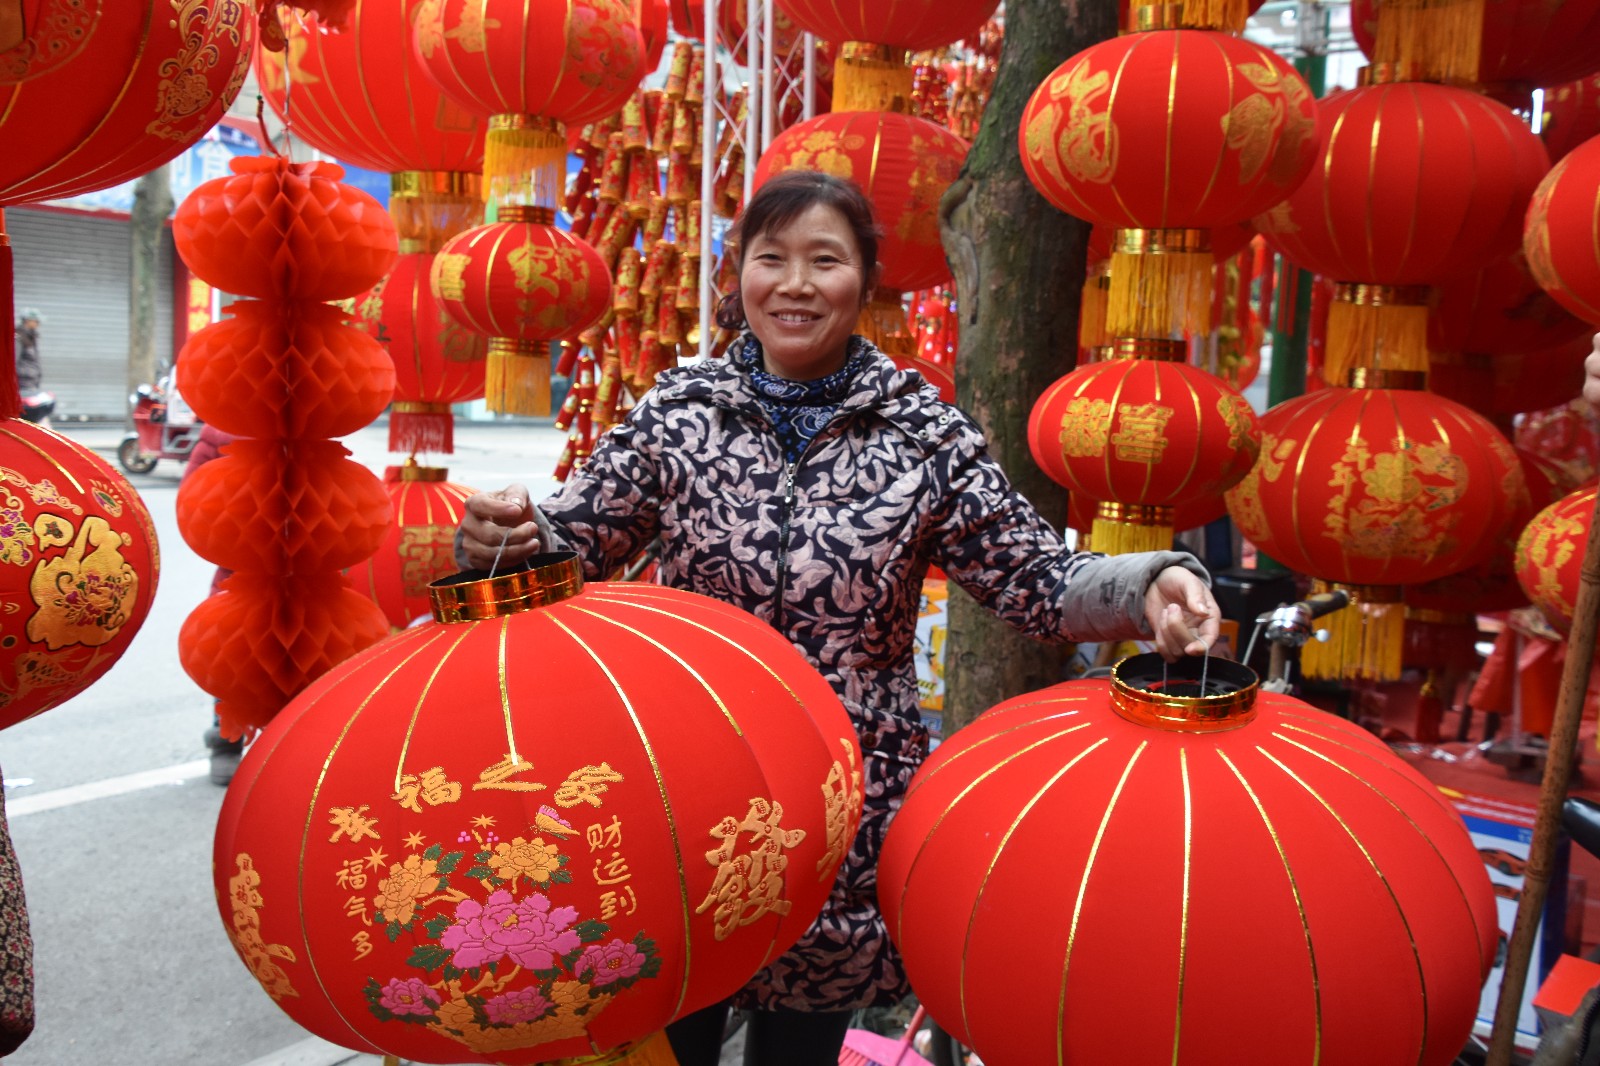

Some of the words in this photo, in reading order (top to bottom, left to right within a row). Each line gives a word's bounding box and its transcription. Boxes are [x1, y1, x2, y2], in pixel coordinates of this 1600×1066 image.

[335, 859, 374, 962] 福气多
[586, 814, 637, 921] 财运到
